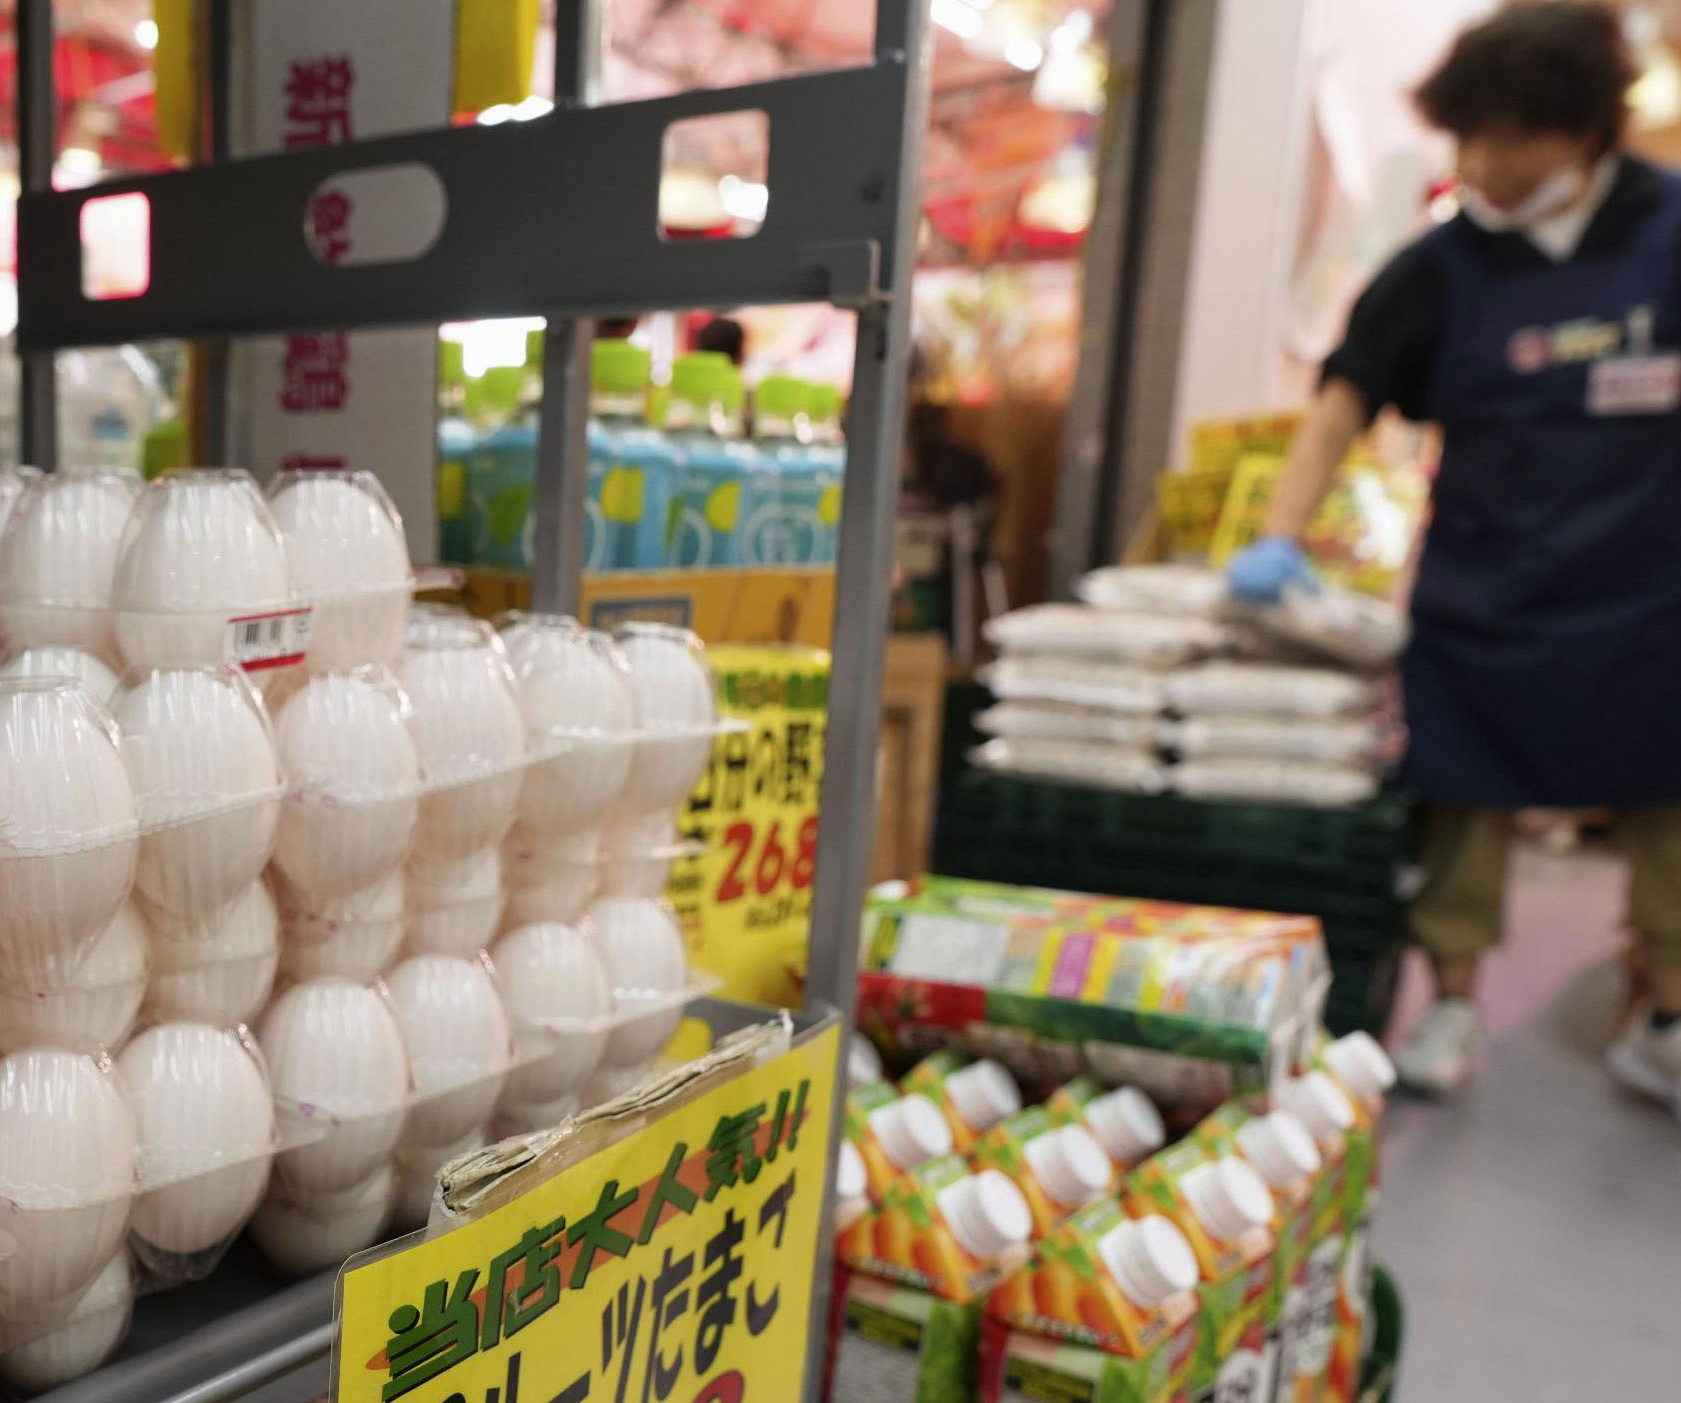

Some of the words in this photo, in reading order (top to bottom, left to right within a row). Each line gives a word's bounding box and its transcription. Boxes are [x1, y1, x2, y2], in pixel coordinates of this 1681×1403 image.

[382, 1079, 810, 1402] 当店大人気!!
